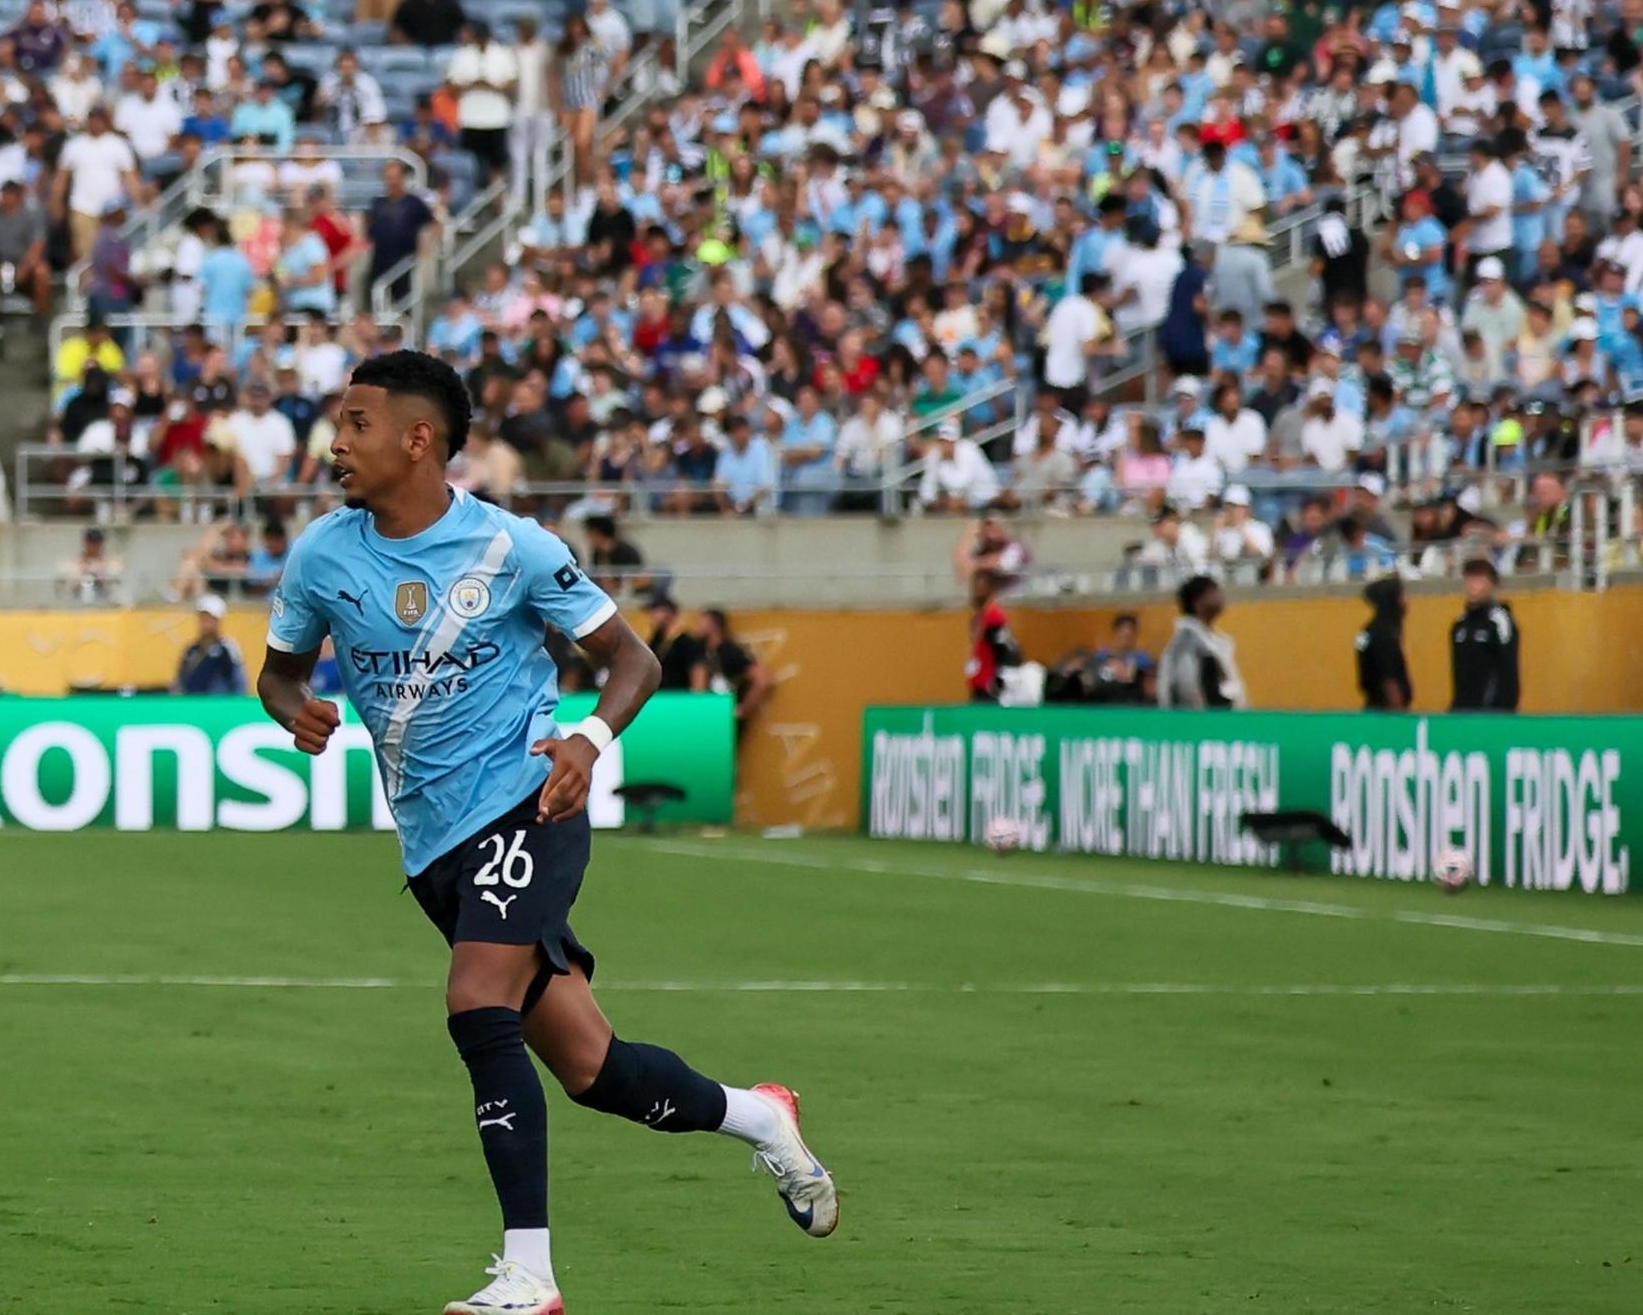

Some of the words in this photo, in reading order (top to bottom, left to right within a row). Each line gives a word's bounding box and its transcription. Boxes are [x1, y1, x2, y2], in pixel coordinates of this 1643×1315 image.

[351, 641, 500, 675] ETIHAD
[376, 677, 468, 699] AIRWAYS
[1060, 736, 1123, 857] MORE
[1125, 736, 1194, 861] THAN
[1505, 746, 1629, 894] FRIDGE,
[474, 829, 534, 888] 26
